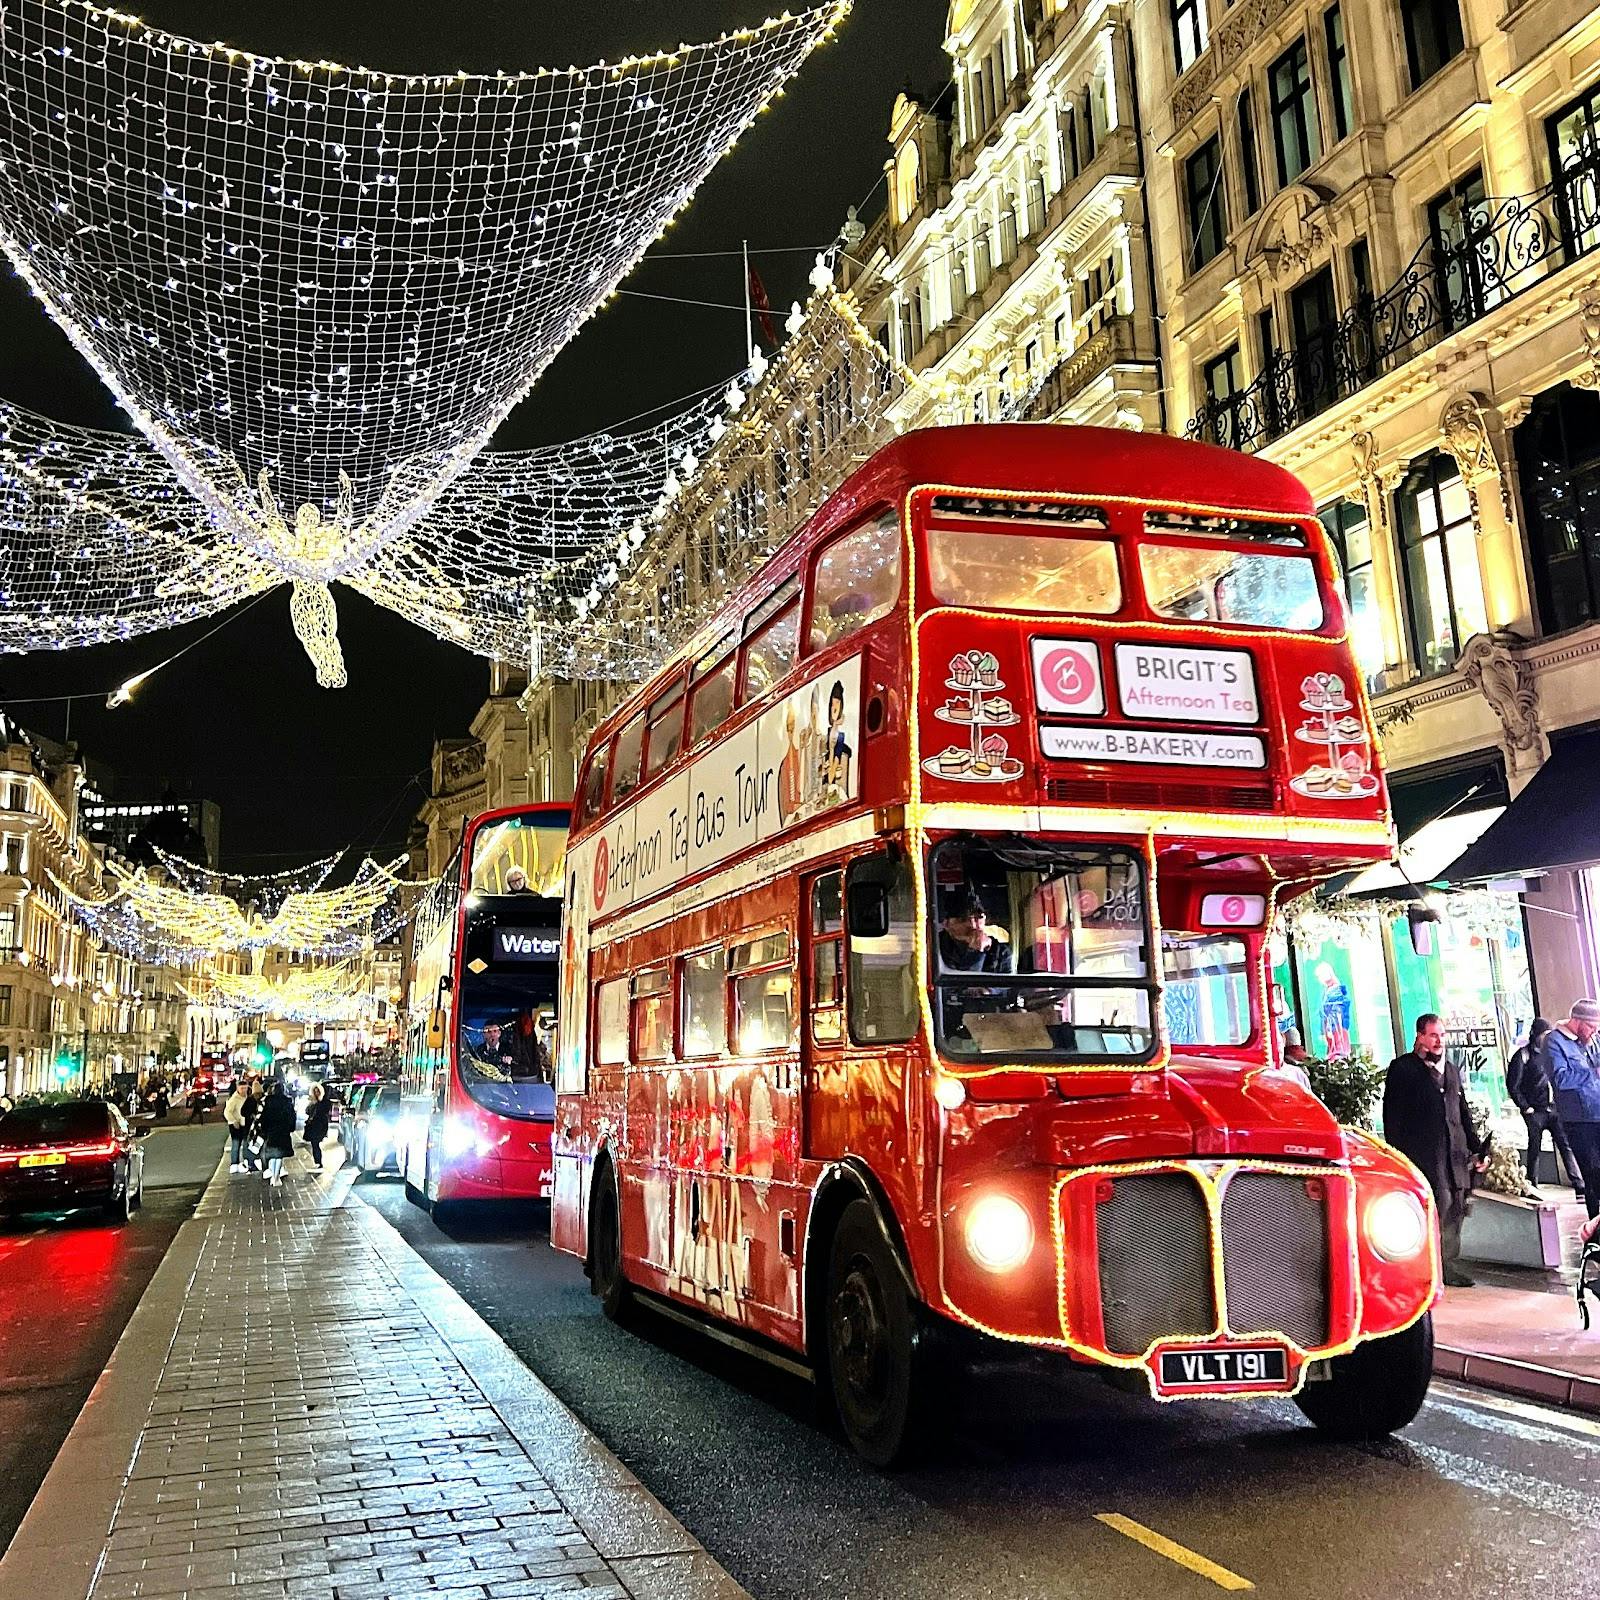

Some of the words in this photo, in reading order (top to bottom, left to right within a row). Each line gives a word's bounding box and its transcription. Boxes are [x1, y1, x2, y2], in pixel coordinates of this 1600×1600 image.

[1135, 655, 1238, 684] BRIGIT'S
[1126, 685, 1216, 710] Afternoon
[1219, 692, 1254, 712] Tea
[1055, 734, 1254, 761] www.B-BAKERY.com
[607, 823, 662, 896] Afternoon
[668, 806, 688, 865] Tea
[695, 791, 725, 849] Bus
[734, 762, 774, 829] Tour
[501, 933, 561, 954] Water
[1470, 1030, 1495, 1046] LEE
[1181, 1354, 1231, 1381] VLT
[1236, 1353, 1267, 1379] 191
